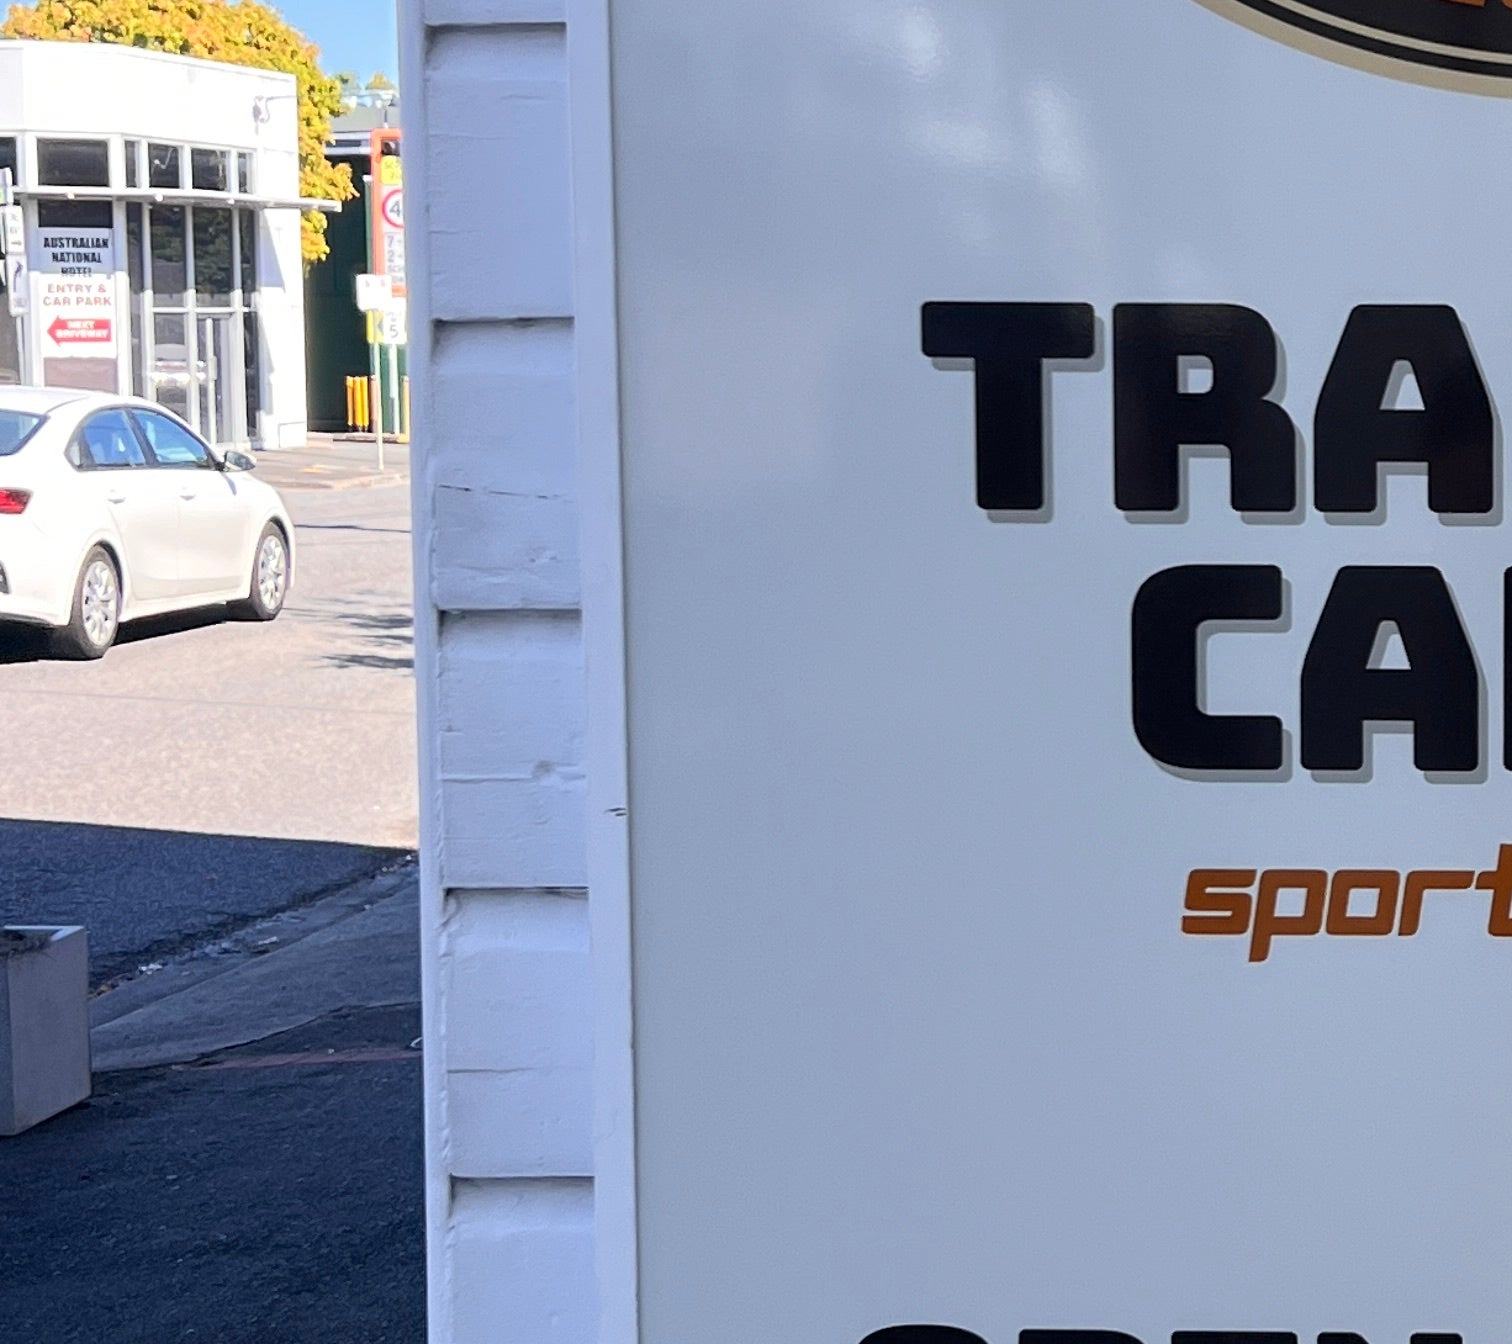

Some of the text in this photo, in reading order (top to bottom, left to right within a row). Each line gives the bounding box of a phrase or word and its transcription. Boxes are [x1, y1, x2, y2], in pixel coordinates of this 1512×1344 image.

[43, 237, 109, 249] AUSTRALIAN
[52, 252, 103, 263] NATIONAL
[61, 267, 92, 277] HOTEL
[48, 284, 92, 293] ENTRY
[43, 296, 112, 306] CAR PARK
